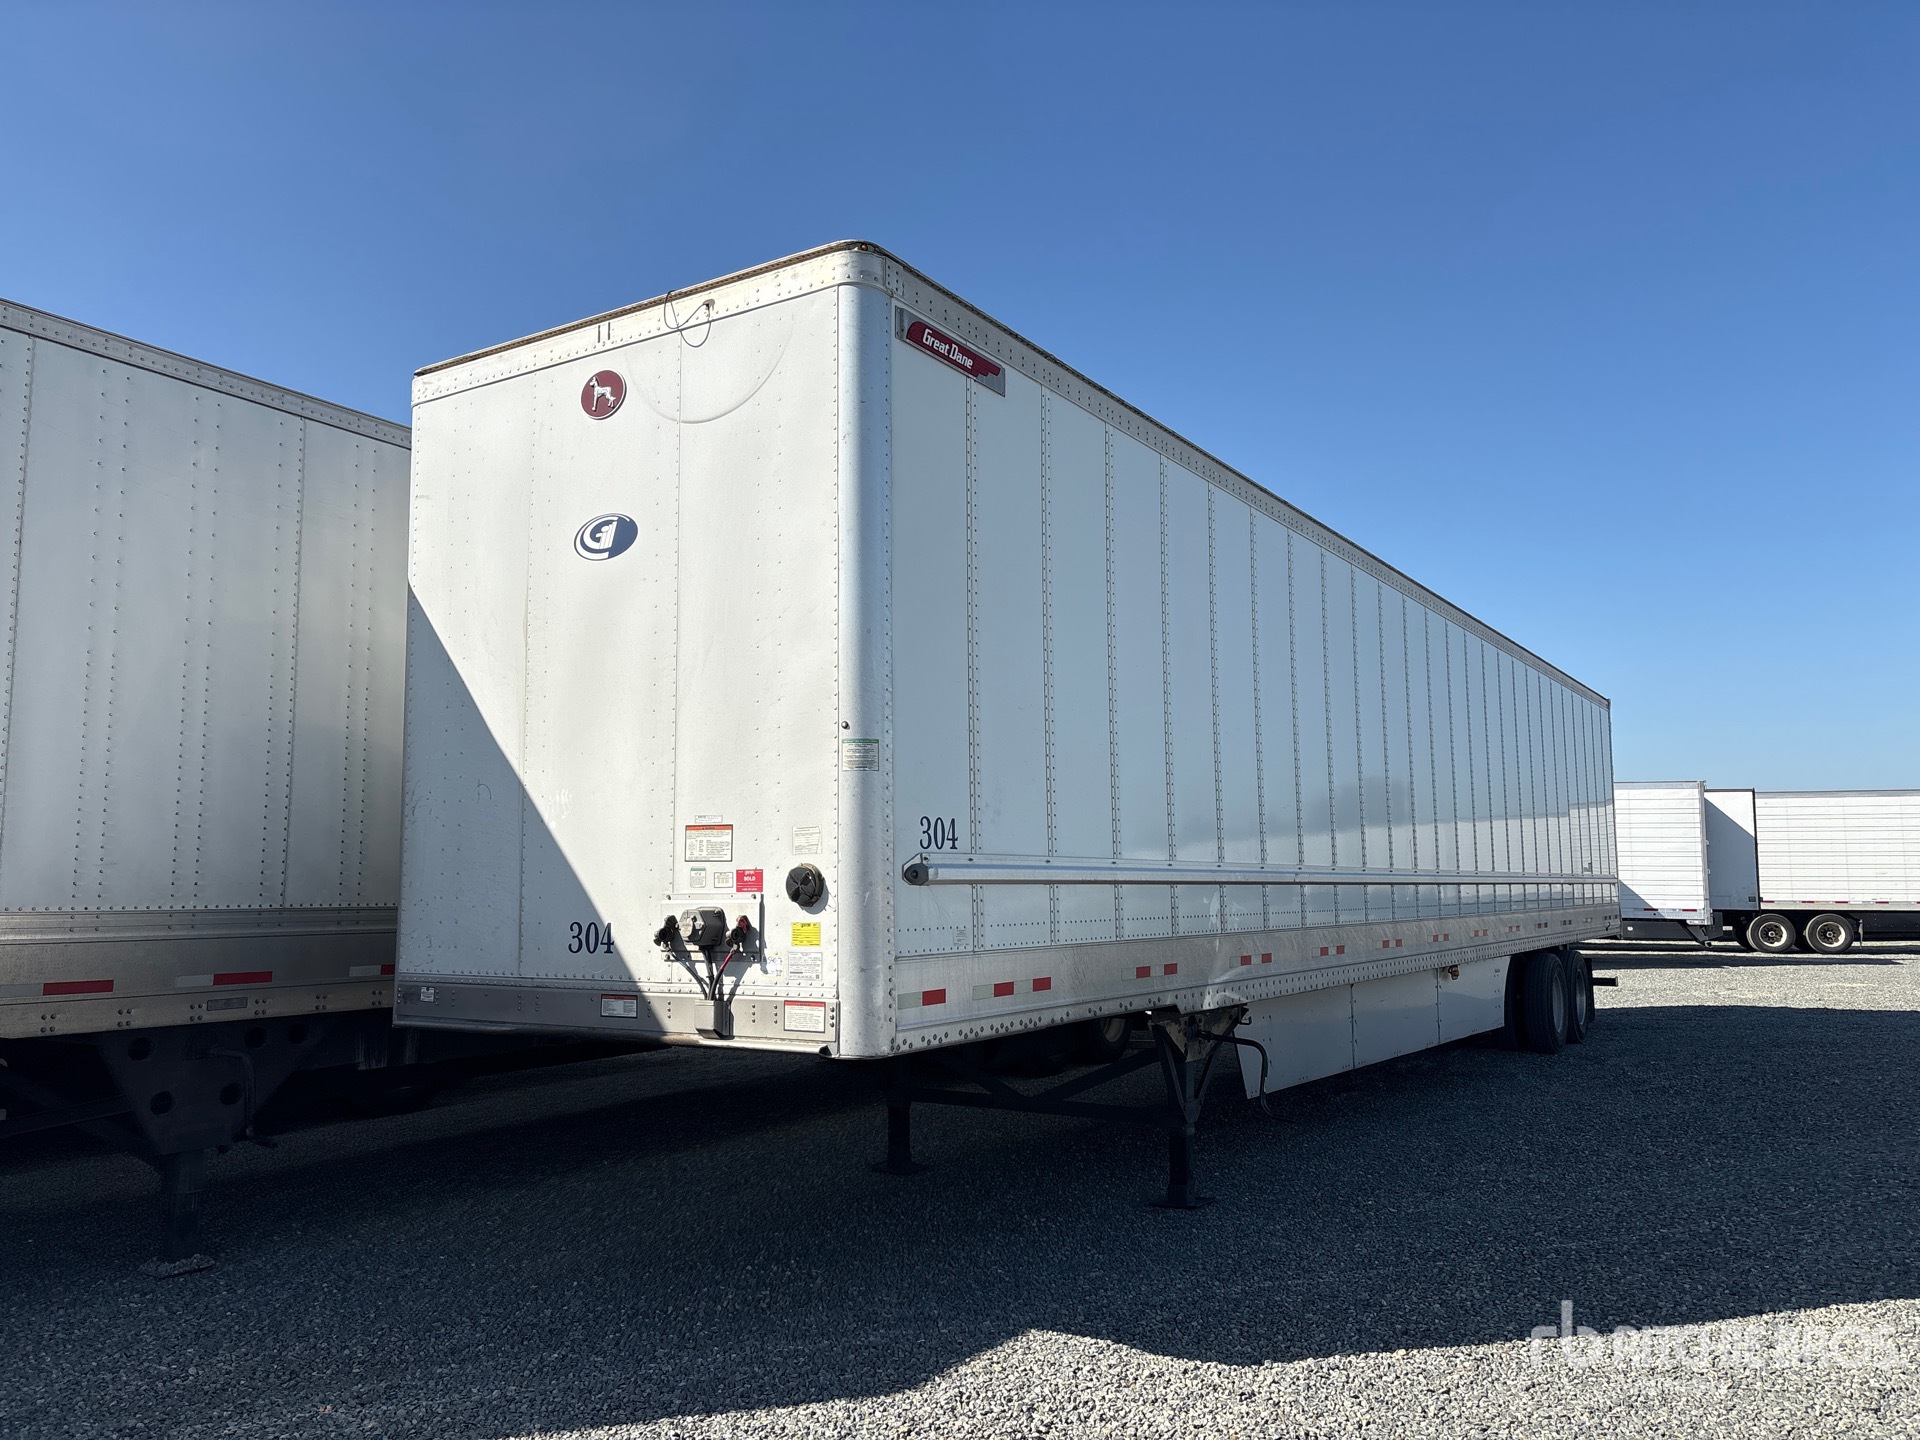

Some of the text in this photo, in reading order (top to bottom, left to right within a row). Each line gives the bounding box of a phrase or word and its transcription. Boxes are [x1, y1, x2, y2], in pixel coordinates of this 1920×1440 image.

[922, 328, 974, 370] Great Dane
[919, 816, 958, 850] 304
[568, 921, 615, 954] 304
